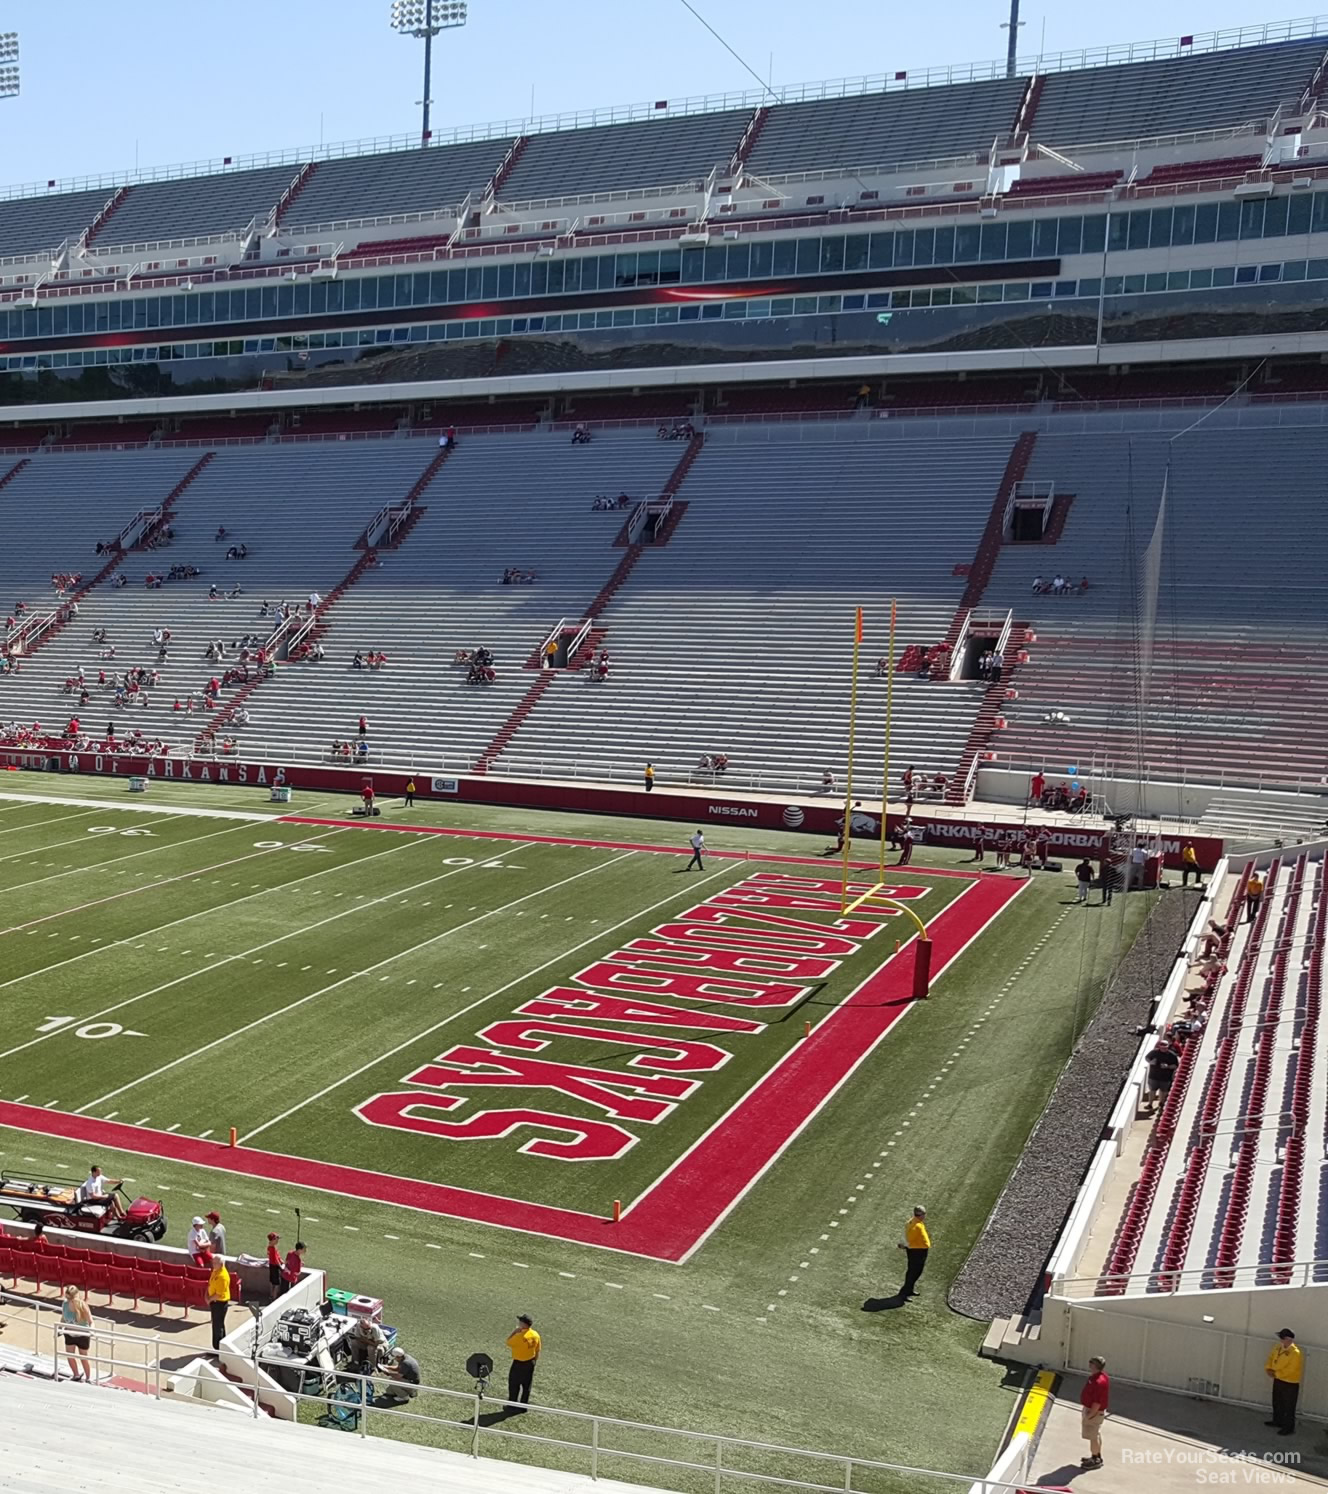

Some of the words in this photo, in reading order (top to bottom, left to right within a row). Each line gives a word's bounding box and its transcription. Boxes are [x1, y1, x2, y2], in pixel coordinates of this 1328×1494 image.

[95, 755, 118, 772] OF
[147, 761, 286, 784] ARKANSAS
[708, 805, 758, 817] NISSAN
[35, 1015, 123, 1039] 10
[351, 872, 933, 1161] RAZORBACKS
